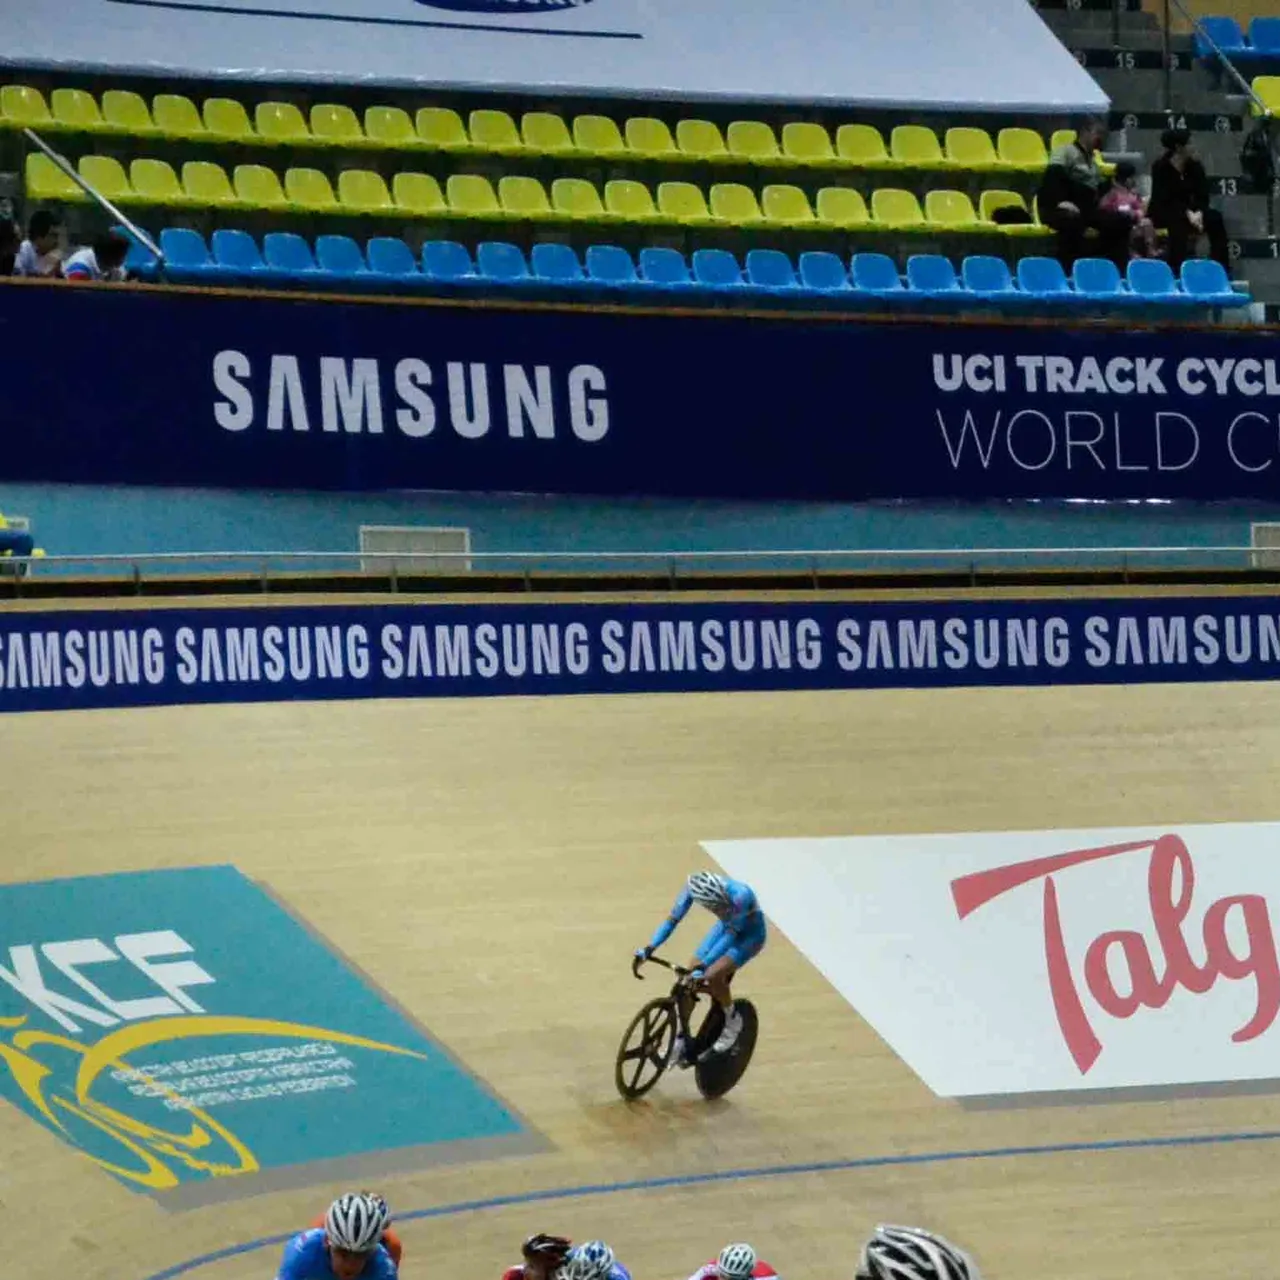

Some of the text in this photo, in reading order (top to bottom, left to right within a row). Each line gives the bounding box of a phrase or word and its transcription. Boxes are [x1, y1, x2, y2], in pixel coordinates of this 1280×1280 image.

[1116, 52, 1135, 68] 15
[1167, 114, 1187, 130] 14
[1218, 178, 1238, 195] 13
[213, 350, 610, 442] SAMSUNG
[933, 354, 1006, 392] UCI
[1016, 355, 1167, 394] TRACK
[935, 409, 1200, 471] WORLD
[0, 628, 165, 688] AMSUNG
[175, 625, 369, 684] SAMSUNG
[381, 622, 589, 678] SAMSUNG
[601, 619, 822, 673] SAMSUNG
[837, 617, 1070, 670] SAMSUNG
[0, 929, 217, 1033] KCF
